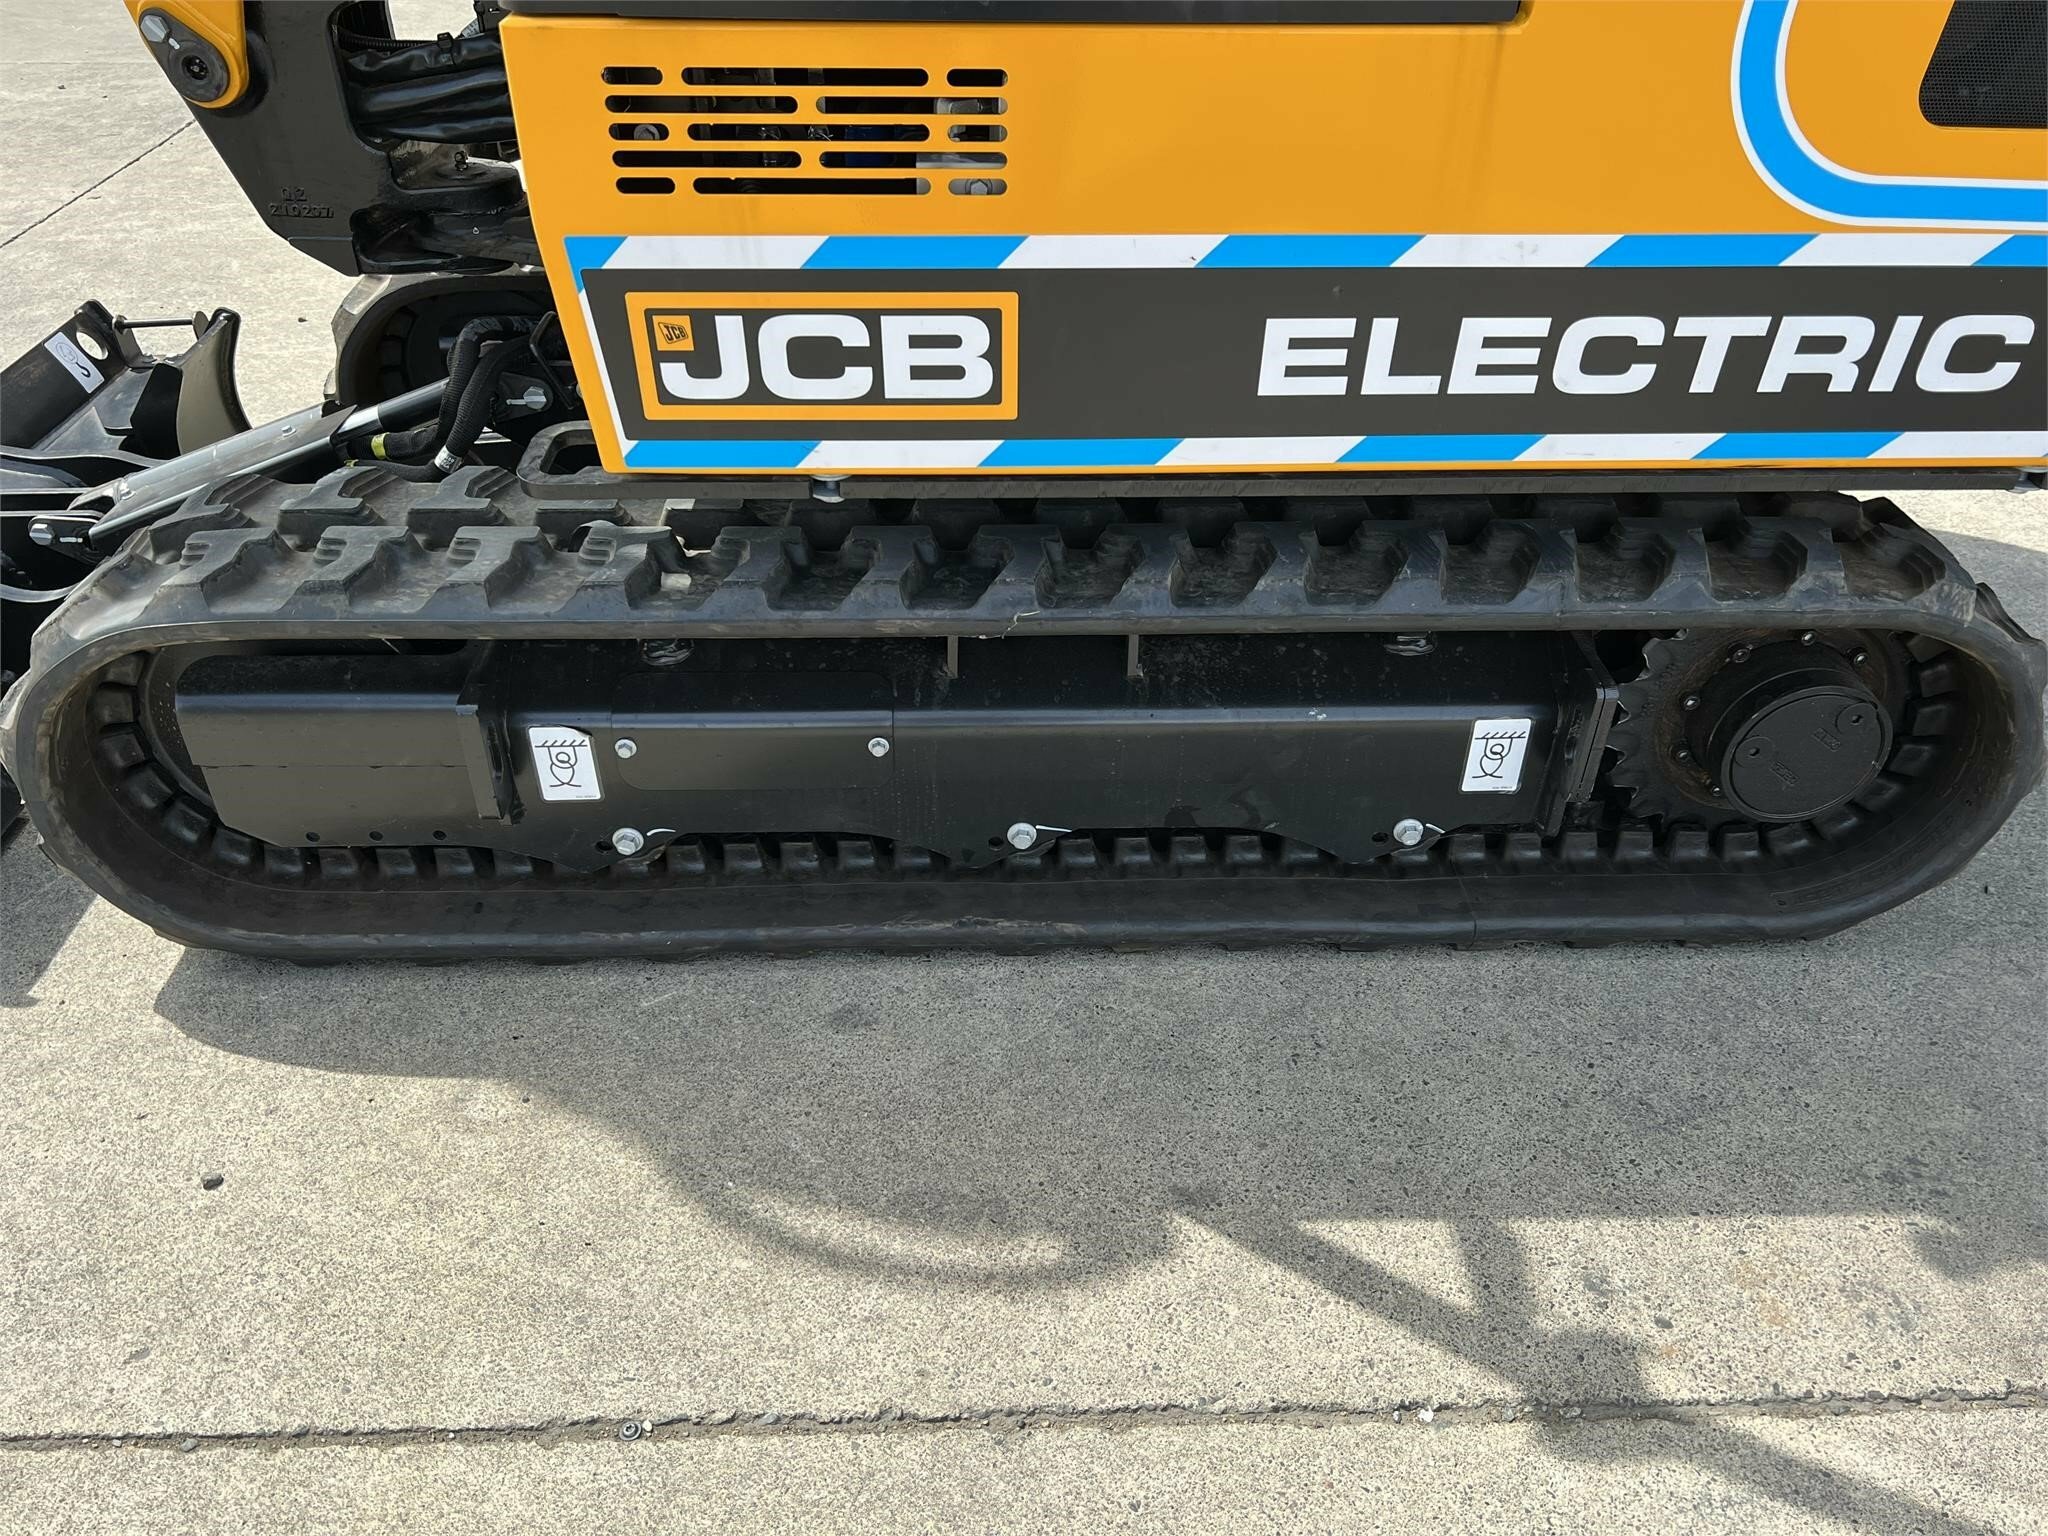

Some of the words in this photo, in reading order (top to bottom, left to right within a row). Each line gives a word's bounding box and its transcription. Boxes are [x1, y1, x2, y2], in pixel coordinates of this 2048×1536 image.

[659, 314, 994, 400] JCB
[663, 324, 686, 341] JCB
[1257, 314, 2036, 397] ELECTRIC
